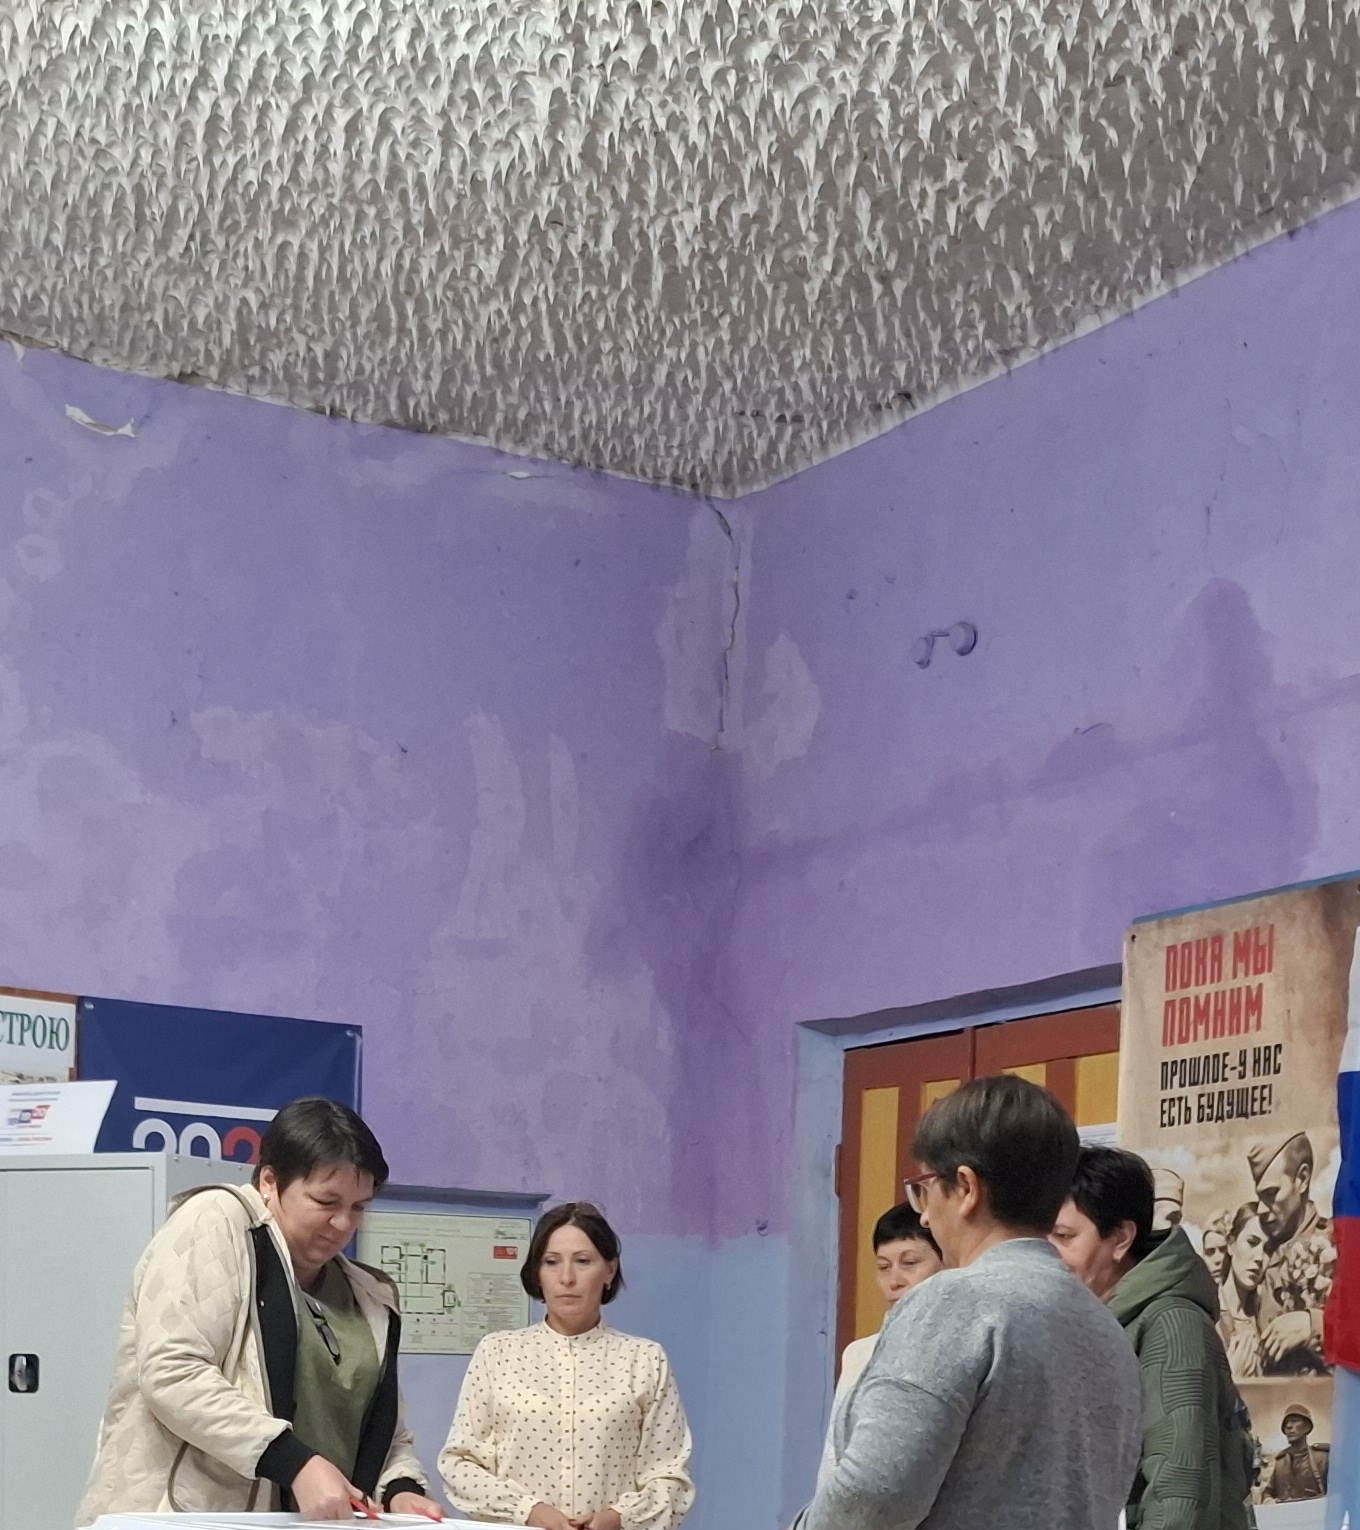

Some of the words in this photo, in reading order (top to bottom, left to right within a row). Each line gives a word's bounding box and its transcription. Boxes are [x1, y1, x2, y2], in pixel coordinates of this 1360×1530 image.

[1165, 937, 1224, 992] ПОКА
[1232, 925, 1275, 979] МЫ
[1162, 984, 1263, 1047] ПОМНИМ
[1252, 1044, 1283, 1077] НАС
[1159, 1097, 1191, 1128] ЕСТЬ
[1196, 1084, 1273, 1124] БУДУЩЕЕ!
